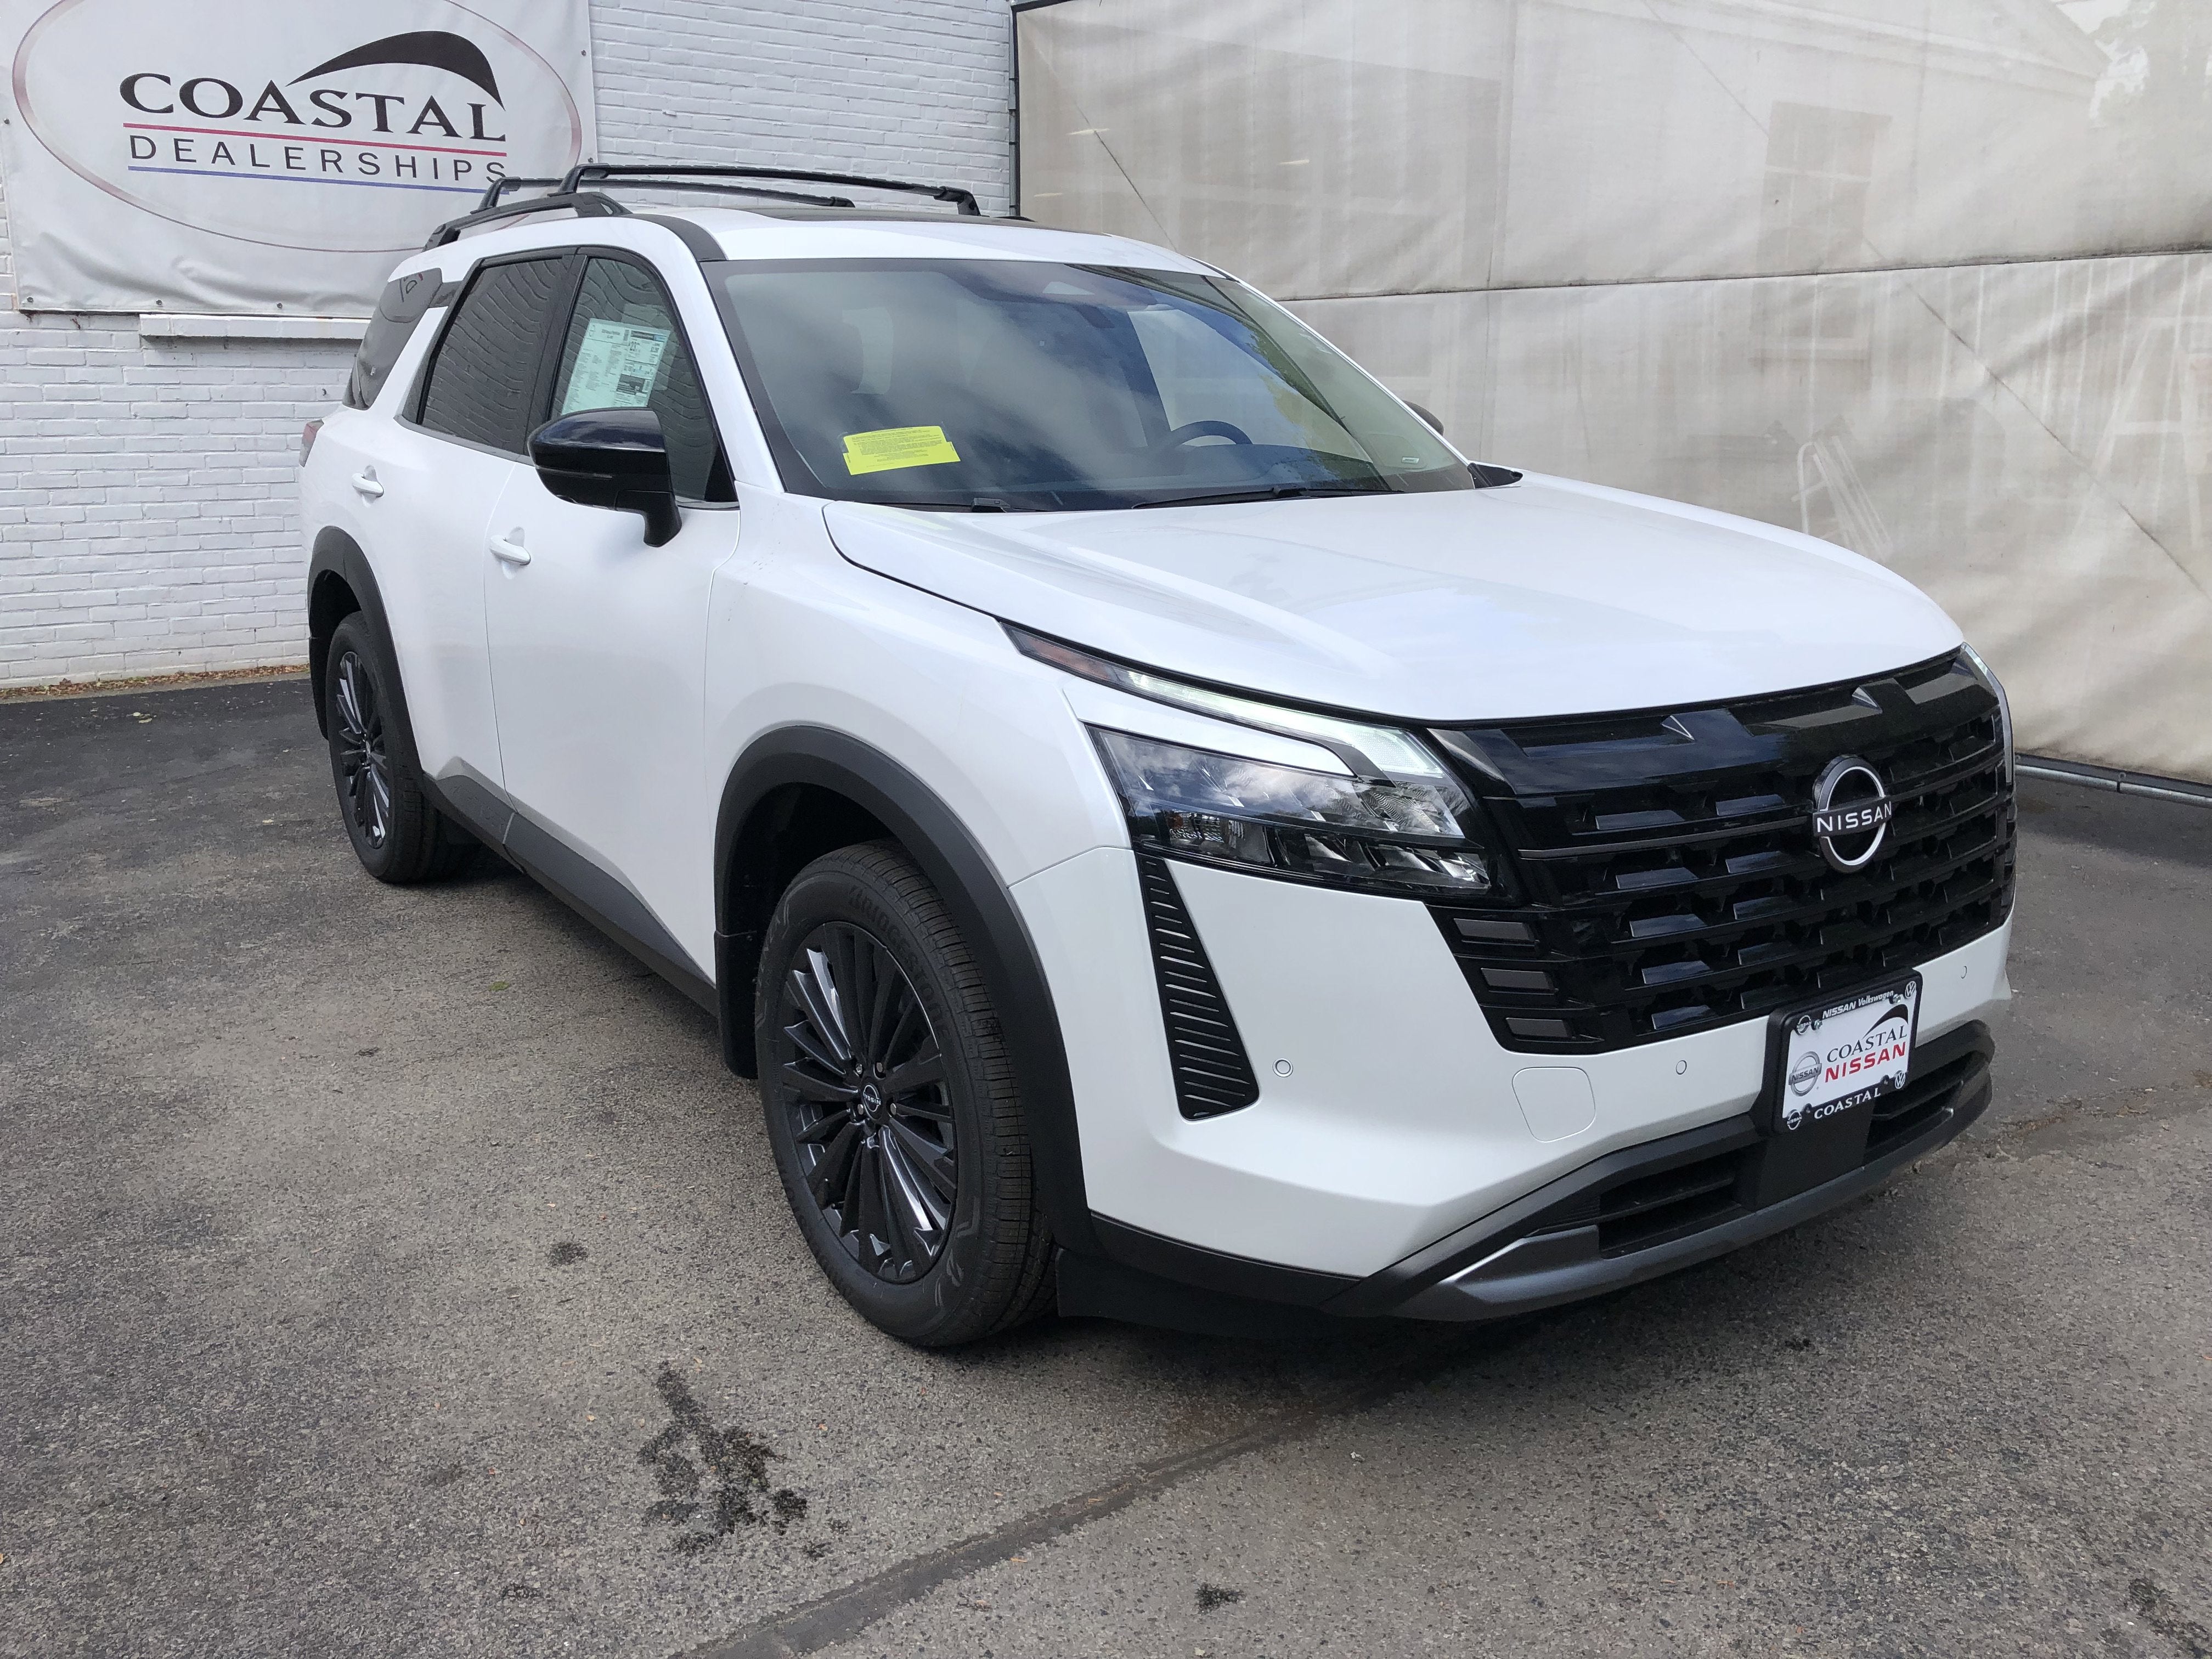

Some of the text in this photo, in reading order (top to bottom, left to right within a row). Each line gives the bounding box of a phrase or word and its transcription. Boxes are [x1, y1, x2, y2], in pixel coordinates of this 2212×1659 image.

[119, 72, 507, 143] COASTAL
[130, 135, 506, 183] DEALERSHIPS
[1816, 801, 1892, 833] NISSAN
[1822, 990, 1894, 1019] NISSAN Volkswagen
[1827, 1025, 1908, 1063] COASTAL
[1791, 1066, 1819, 1082] NISSAN
[1825, 1041, 1906, 1083] NISSAN
[1814, 1087, 1881, 1120] COASTAL
